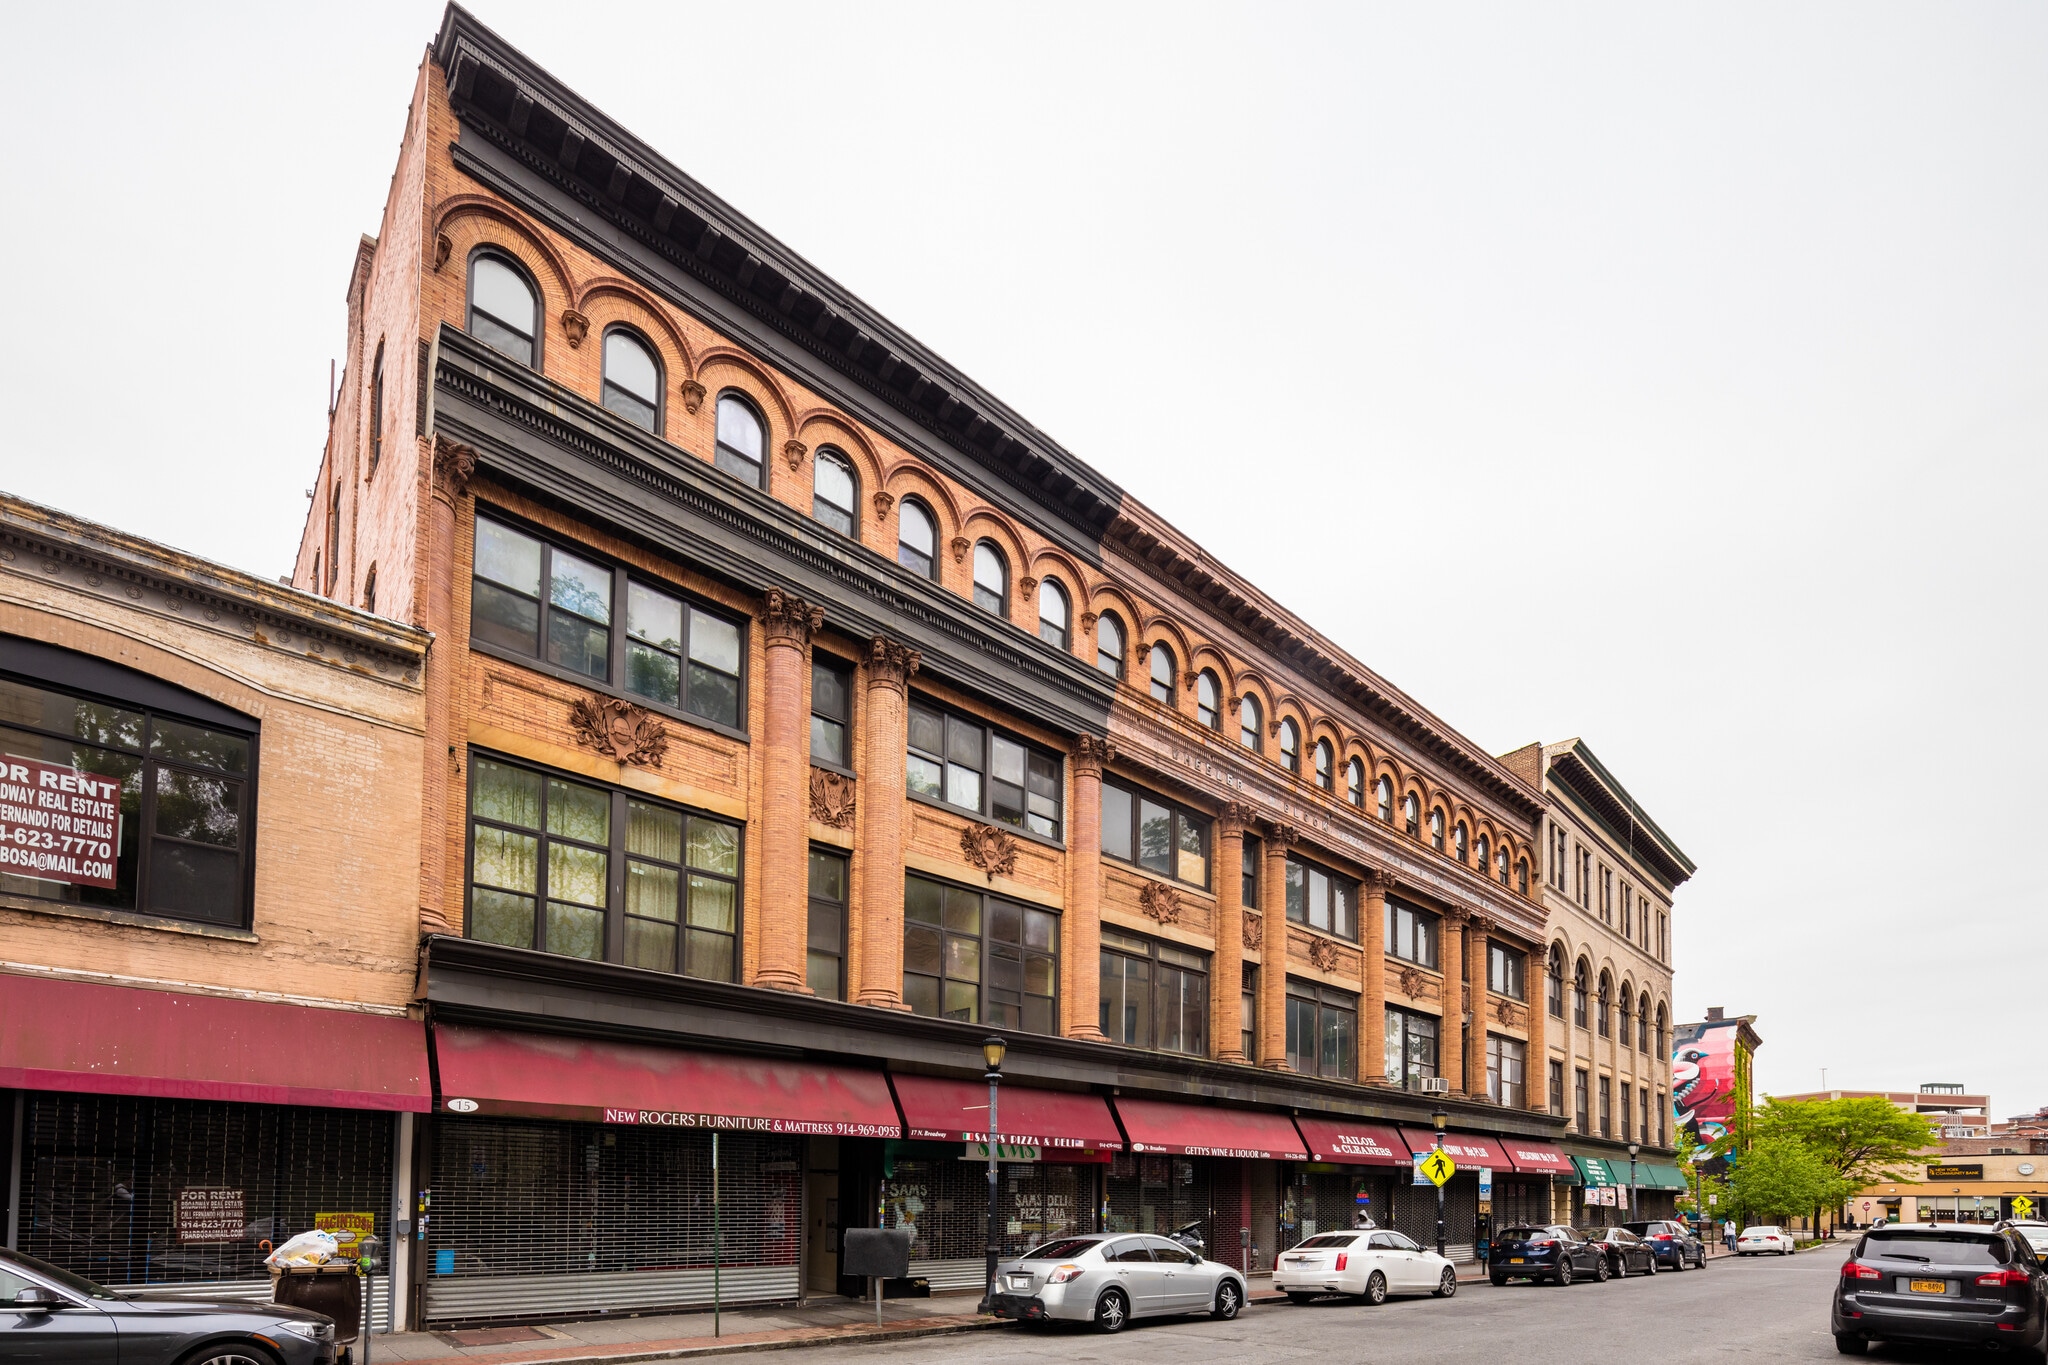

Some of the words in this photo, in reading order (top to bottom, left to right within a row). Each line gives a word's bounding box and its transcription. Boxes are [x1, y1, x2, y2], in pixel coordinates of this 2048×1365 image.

[1171, 747, 1243, 792] WHEELER
[40, 769, 116, 800] RENT
[38, 790, 68, 812] REAL
[71, 796, 115, 820] ESTATE
[52, 813, 71, 832] FOR
[73, 817, 112, 840] DETAILS
[456, 1101, 470, 1111] 15
[639, 1111, 695, 1126] ROGERS
[699, 1115, 771, 1130] FURNITURE
[774, 1119, 783, 1131] &
[784, 1120, 833, 1134] MATTRESS
[836, 1122, 900, 1137] 914-969-0955
[924, 1130, 947, 1139] Broadway
[974, 1132, 1006, 1143] SA'S
[1010, 1135, 1039, 1145] PIZZA
[1043, 1137, 1050, 1146] &
[1054, 1138, 1074, 1148] DELI
[1337, 1135, 1377, 1147] TAILOR
[1210, 1148, 1228, 1157] WINE
[1228, 1149, 1234, 1157] &
[1235, 1149, 1259, 1159] LIQUOR
[1332, 1143, 1342, 1153] &
[1341, 1145, 1393, 1157] CLEANERS
[1472, 1147, 1489, 1157] PLUS
[181, 1191, 207, 1200] FOR
[210, 1190, 243, 1200] RENT
[889, 1182, 928, 1197] SAMS
[210, 1201, 223, 1209] REAL
[224, 1200, 244, 1209] ESTATE
[1014, 1193, 1042, 1208] SAMS
[181, 1220, 243, 1229] 914-623-7770
